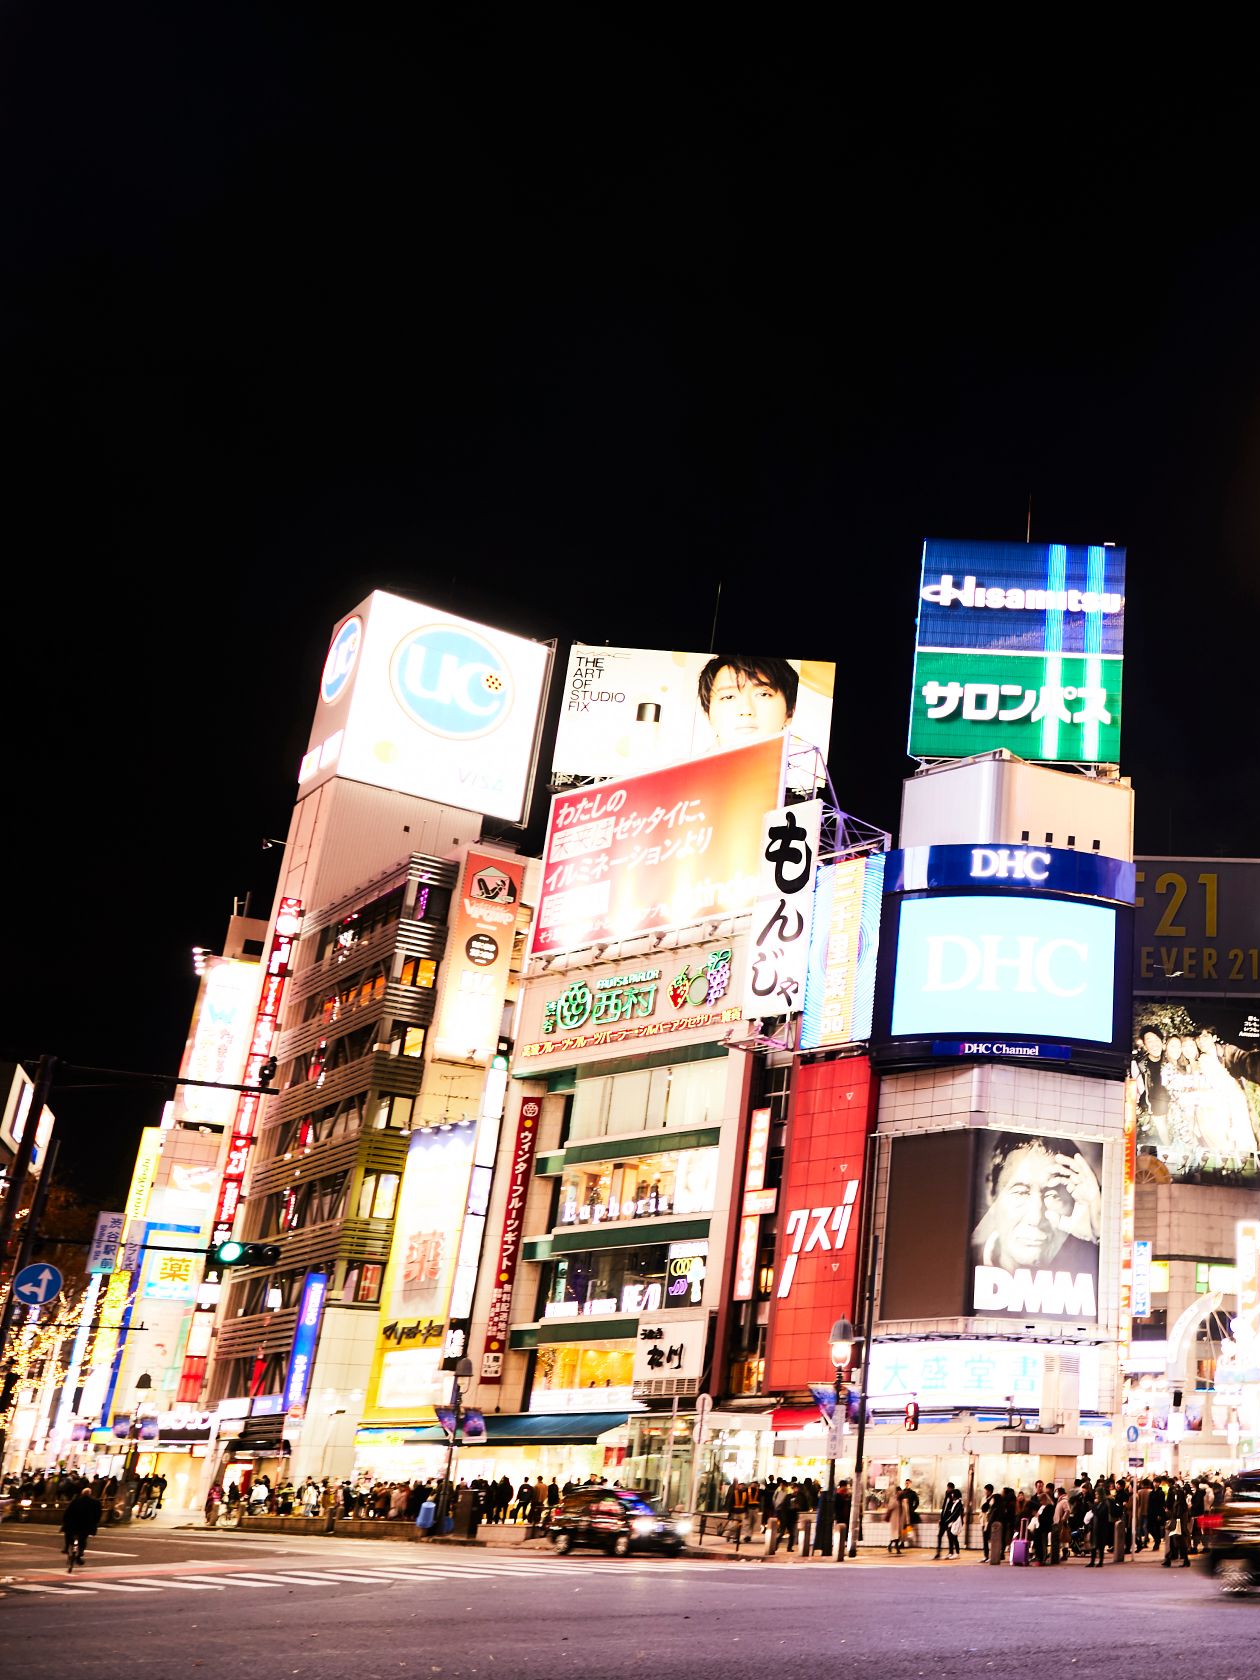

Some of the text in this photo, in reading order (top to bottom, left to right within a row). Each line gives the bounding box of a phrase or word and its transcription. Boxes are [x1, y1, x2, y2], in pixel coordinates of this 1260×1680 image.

[920, 574, 1124, 613] Hisamitsu
[403, 642, 504, 717] UC
[573, 668, 605, 679] ART
[576, 656, 605, 668] THE
[570, 689, 626, 703] STUDIO
[572, 678, 593, 690] OF
[921, 680, 1112, 725] サロンパス
[567, 701, 590, 713] FIX
[556, 789, 628, 828] わたしの
[545, 827, 714, 892] イルミネーションより
[969, 848, 1051, 880] DHC
[752, 811, 812, 1006] もんじゃ
[920, 934, 1089, 998] DHC
[1228, 948, 1260, 981] 21
[591, 985, 657, 1025] 西村
[963, 1042, 1039, 1056] DHC Channel
[561, 1192, 669, 1225] Euphoria
[402, 1229, 446, 1283] 薬
[776, 1179, 860, 1299] クスリ
[158, 1256, 193, 1283] 薬
[973, 1264, 1097, 1317] DMM
